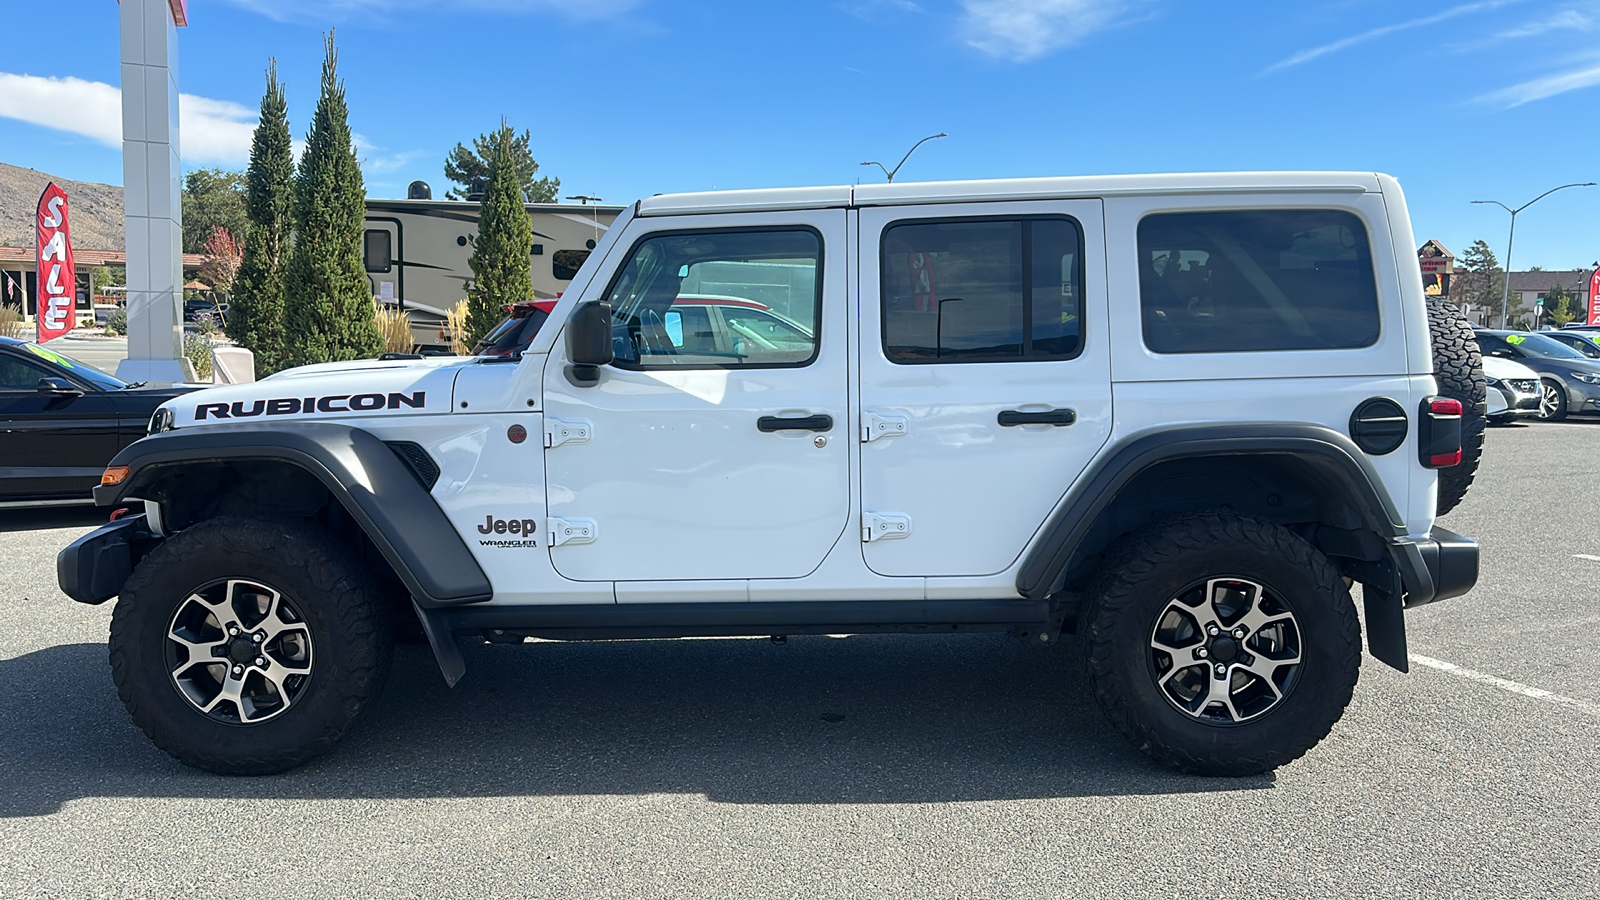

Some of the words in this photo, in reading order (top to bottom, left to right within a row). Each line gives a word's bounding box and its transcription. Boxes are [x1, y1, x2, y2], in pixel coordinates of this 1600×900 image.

[42, 195, 72, 330] SALE
[194, 391, 426, 420] RUBICON
[477, 514, 537, 538] Jeep
